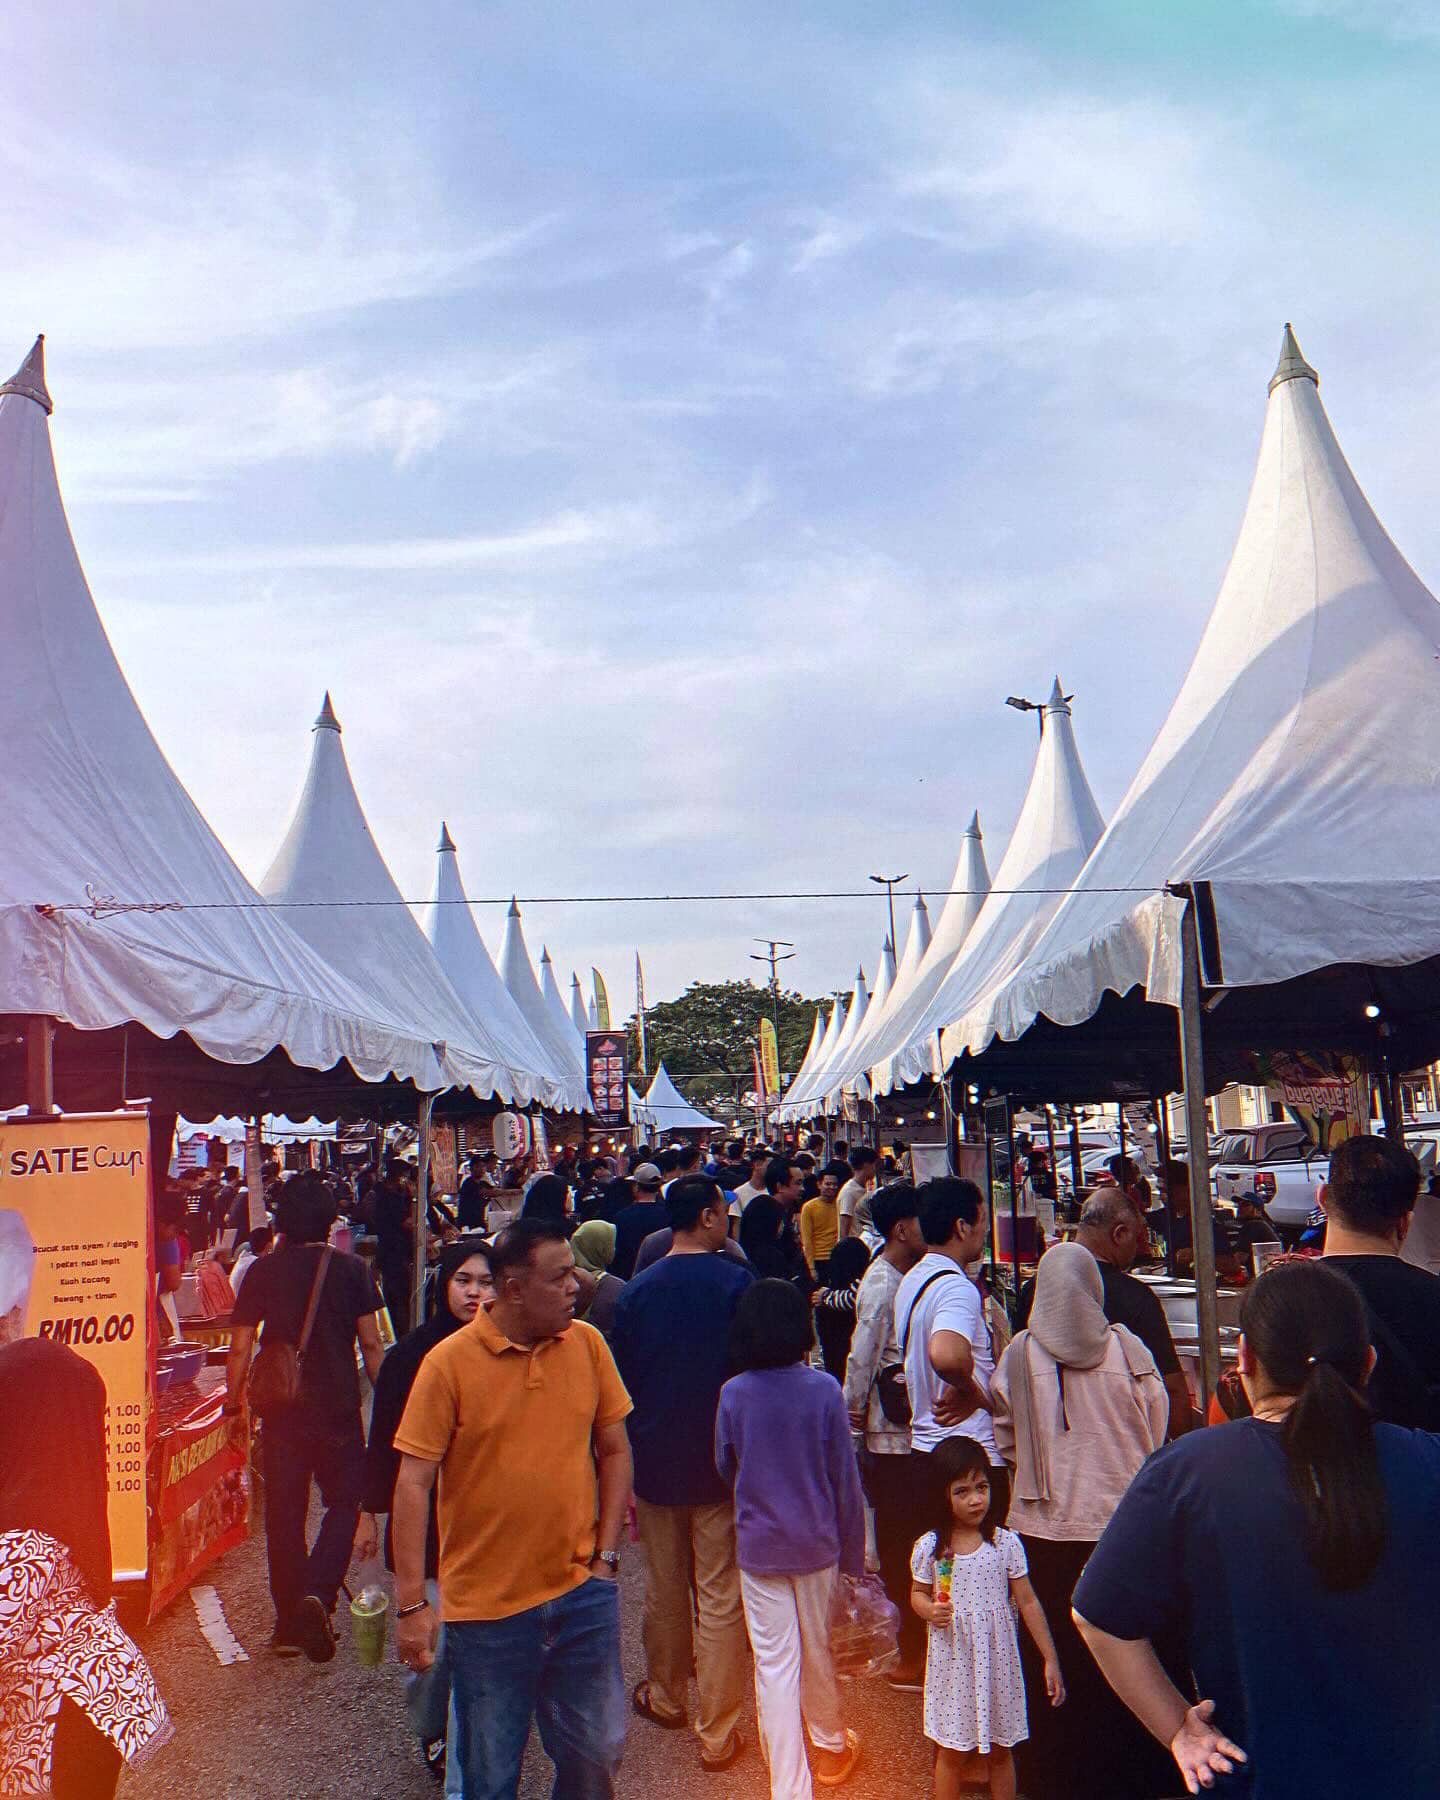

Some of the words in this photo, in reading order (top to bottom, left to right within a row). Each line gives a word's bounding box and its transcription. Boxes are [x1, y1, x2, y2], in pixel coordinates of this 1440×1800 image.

[10, 1147, 89, 1176] SATE
[93, 1146, 145, 1177] Cup
[82, 1242, 104, 1251] ayam
[81, 1275, 111, 1285] Kacang
[53, 1294, 84, 1304] Bawang
[38, 1313, 135, 1345] RM10.00
[116, 1404, 141, 1417] 1.00
[116, 1423, 141, 1435] 1.00
[116, 1442, 141, 1454] 1.00
[116, 1460, 141, 1473] 1.00
[116, 1479, 141, 1491] 1.00
